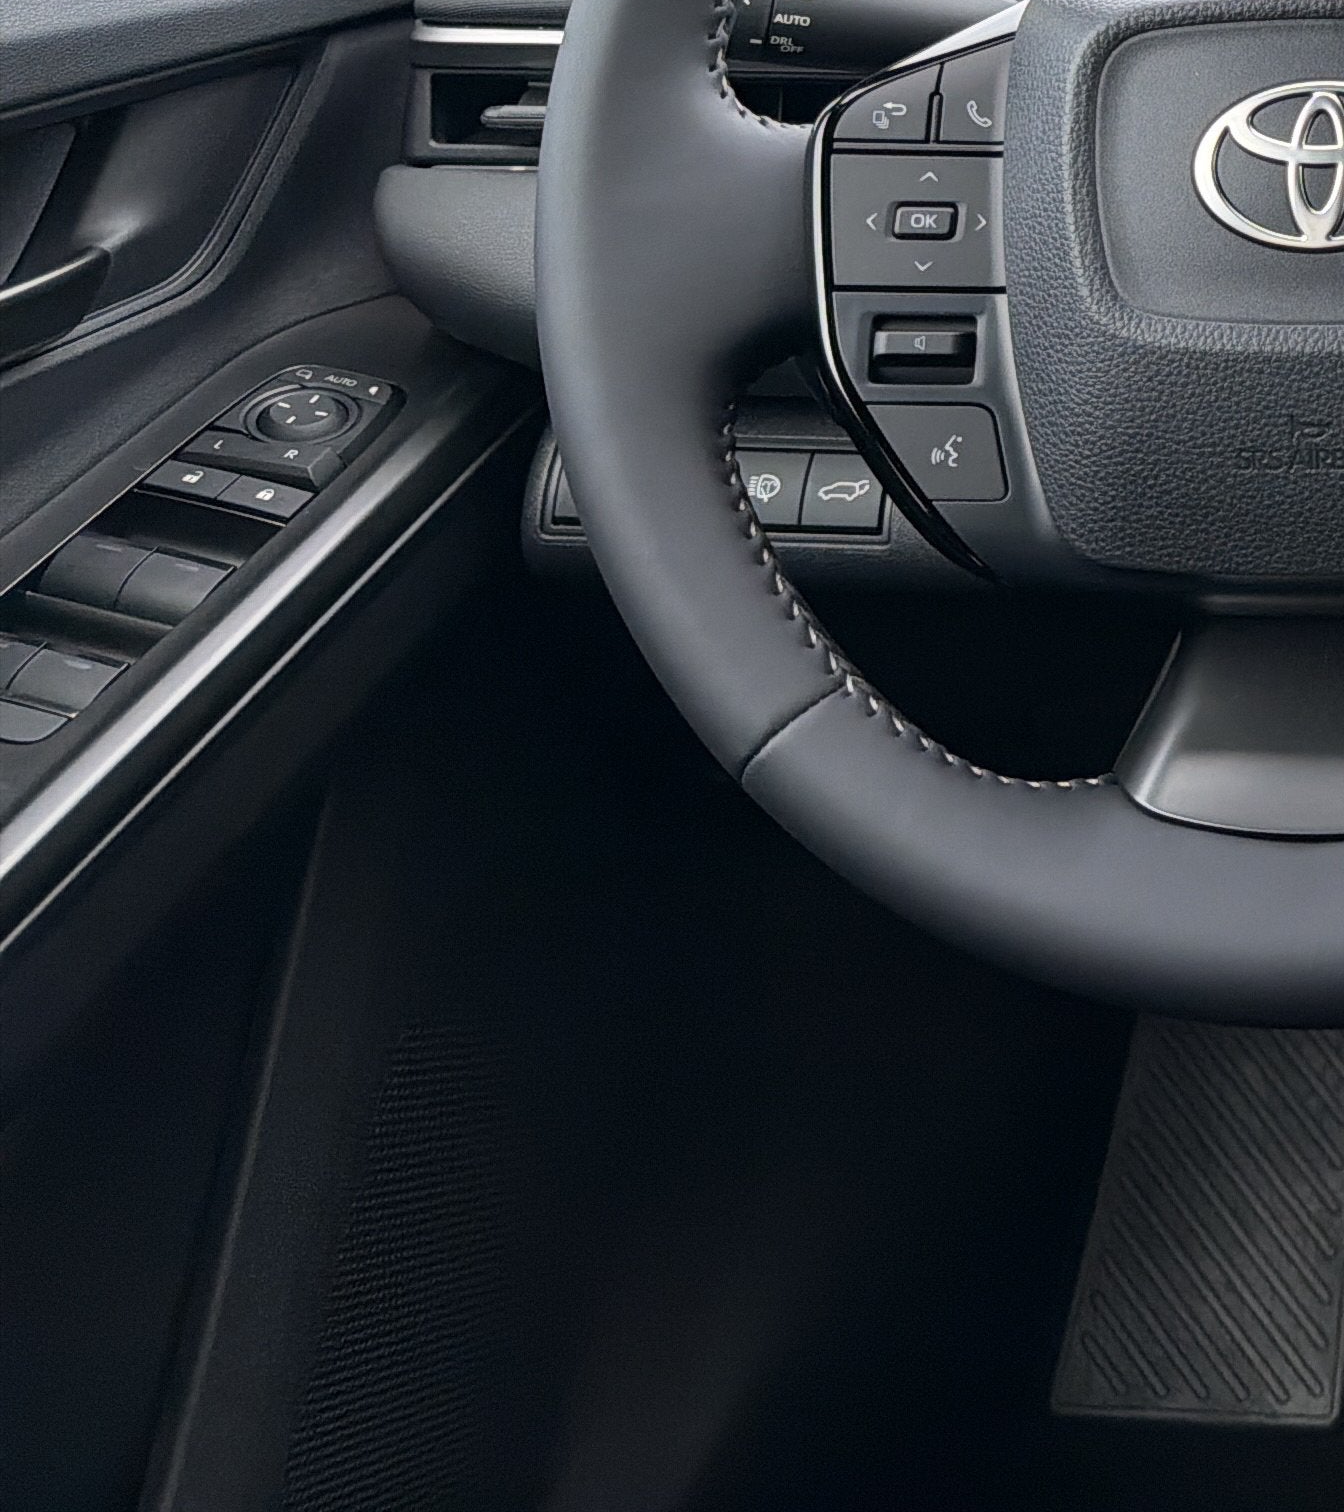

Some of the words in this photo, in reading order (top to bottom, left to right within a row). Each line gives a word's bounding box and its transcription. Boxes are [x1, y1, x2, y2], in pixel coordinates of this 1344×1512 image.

[773, 14, 811, 27] AUTO
[770, 35, 794, 46] DRL
[781, 44, 803, 54] OFF
[910, 214, 937, 228] OK
[324, 374, 358, 387] AUTO
[213, 439, 224, 450] L
[283, 449, 299, 460] R
